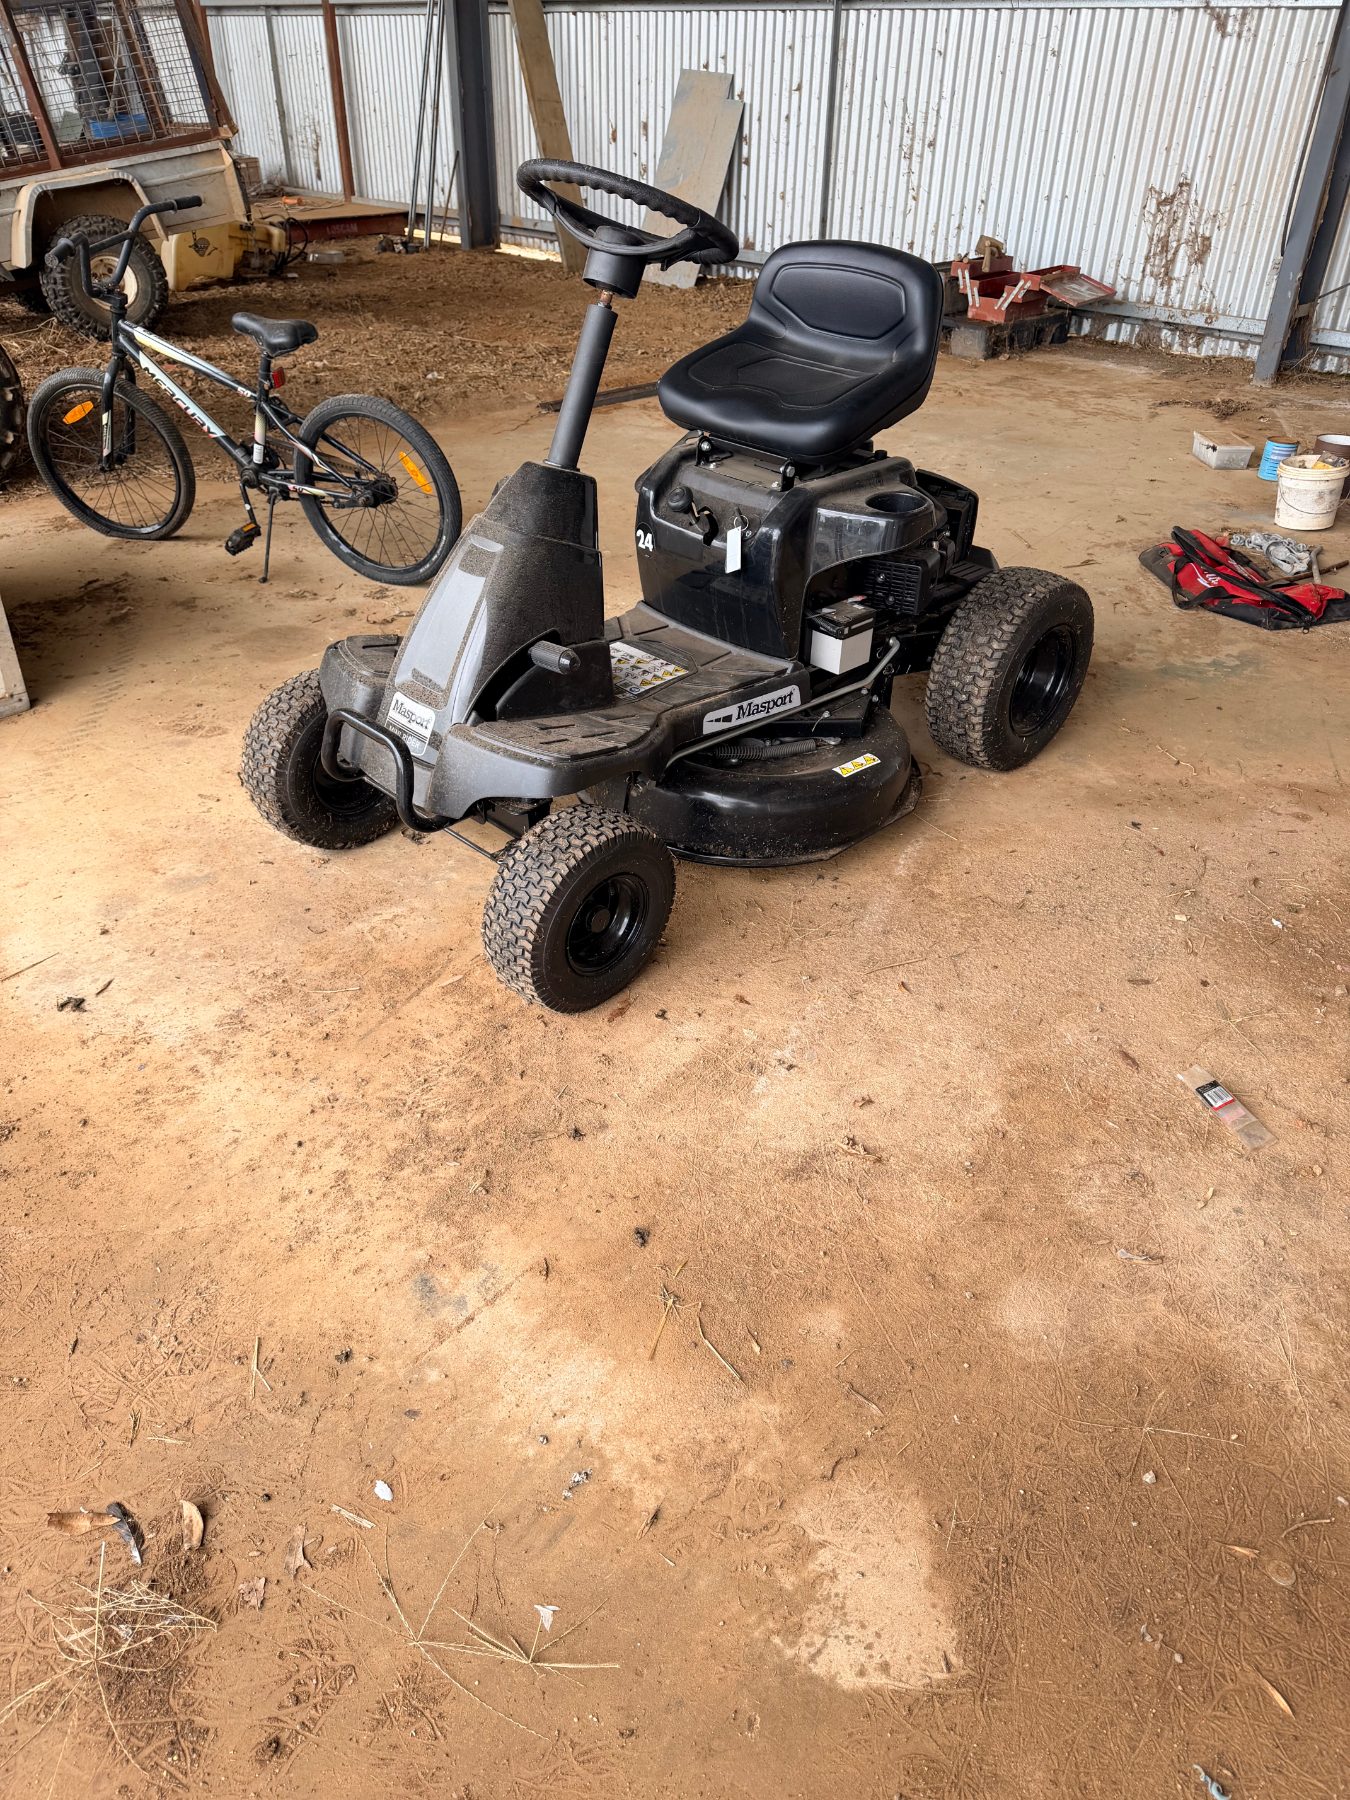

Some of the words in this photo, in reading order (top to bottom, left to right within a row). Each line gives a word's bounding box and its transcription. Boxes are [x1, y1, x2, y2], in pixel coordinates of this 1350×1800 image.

[141, 366, 217, 435] MERCURY
[636, 529, 653, 551] 24
[392, 699, 431, 730] Masport
[735, 691, 794, 720] Masport
